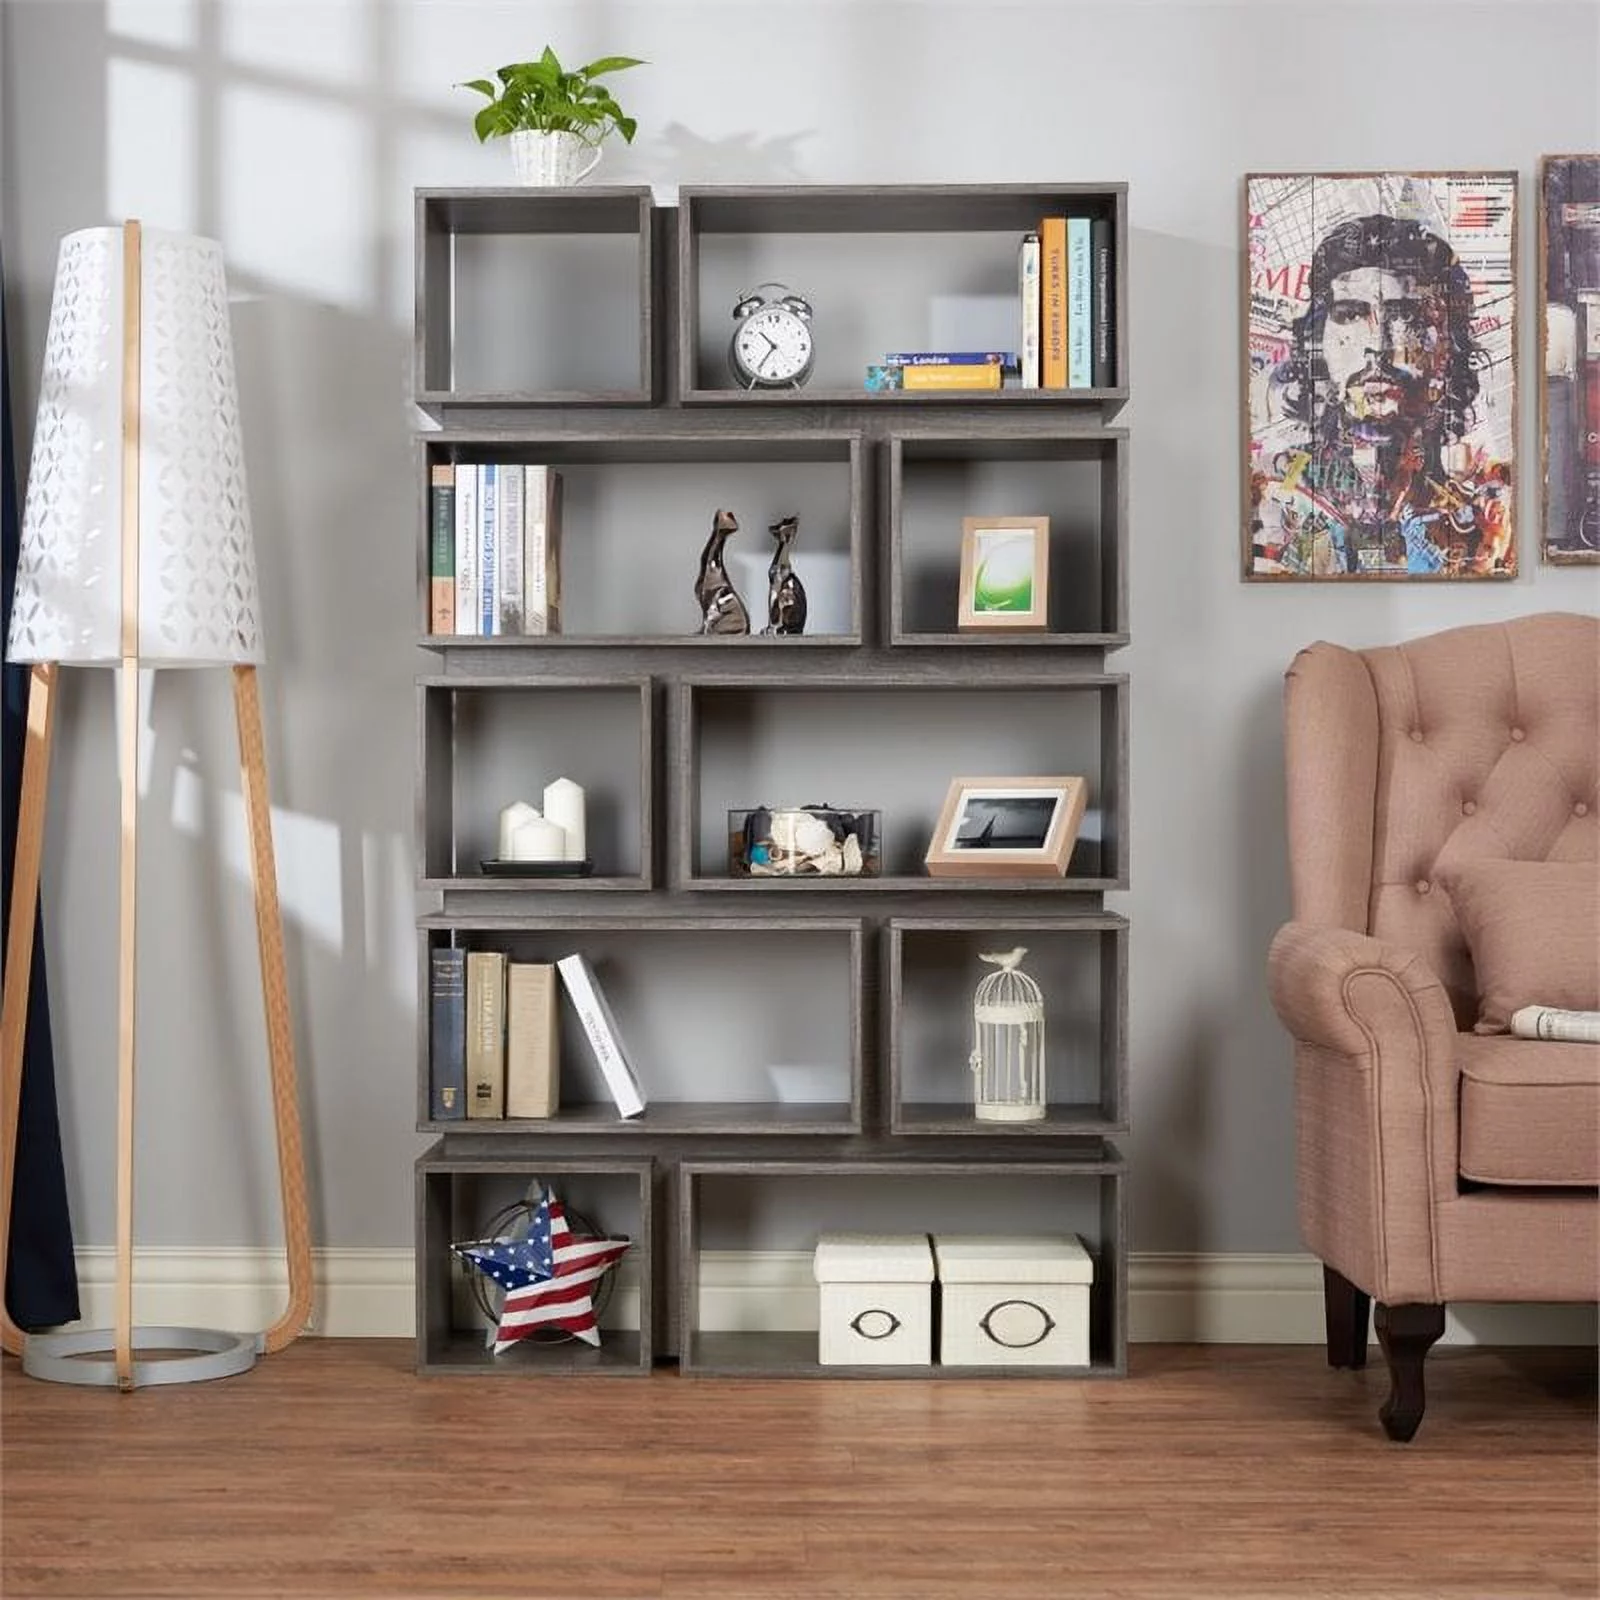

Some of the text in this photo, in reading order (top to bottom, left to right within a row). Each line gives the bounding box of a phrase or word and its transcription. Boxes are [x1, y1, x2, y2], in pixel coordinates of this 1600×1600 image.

[1049, 248, 1061, 361] TURKS IN EUROPE
